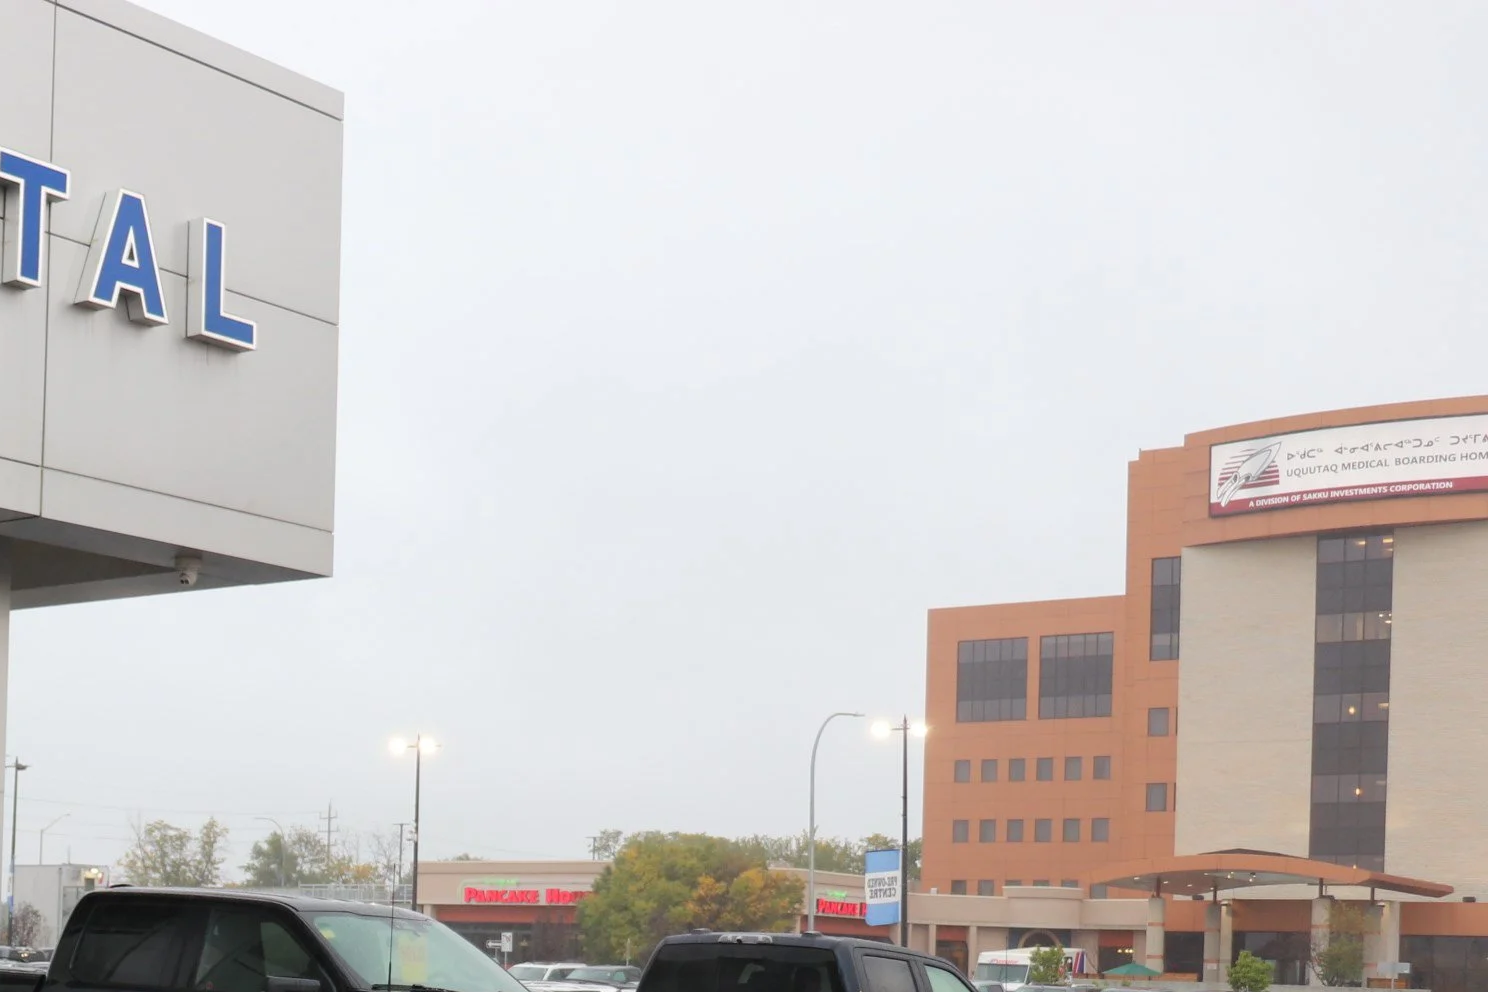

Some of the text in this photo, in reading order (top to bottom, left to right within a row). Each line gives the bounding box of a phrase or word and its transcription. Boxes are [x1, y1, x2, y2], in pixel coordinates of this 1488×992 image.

[1287, 451, 1488, 478] UQUUTAQ MEDICAL BOARDING HOM
[1256, 497, 1289, 507] DIVISION
[1303, 491, 1329, 501] SAKKU
[1330, 486, 1388, 498] INVESTMENTS
[1390, 481, 1453, 493] CORPORATION
